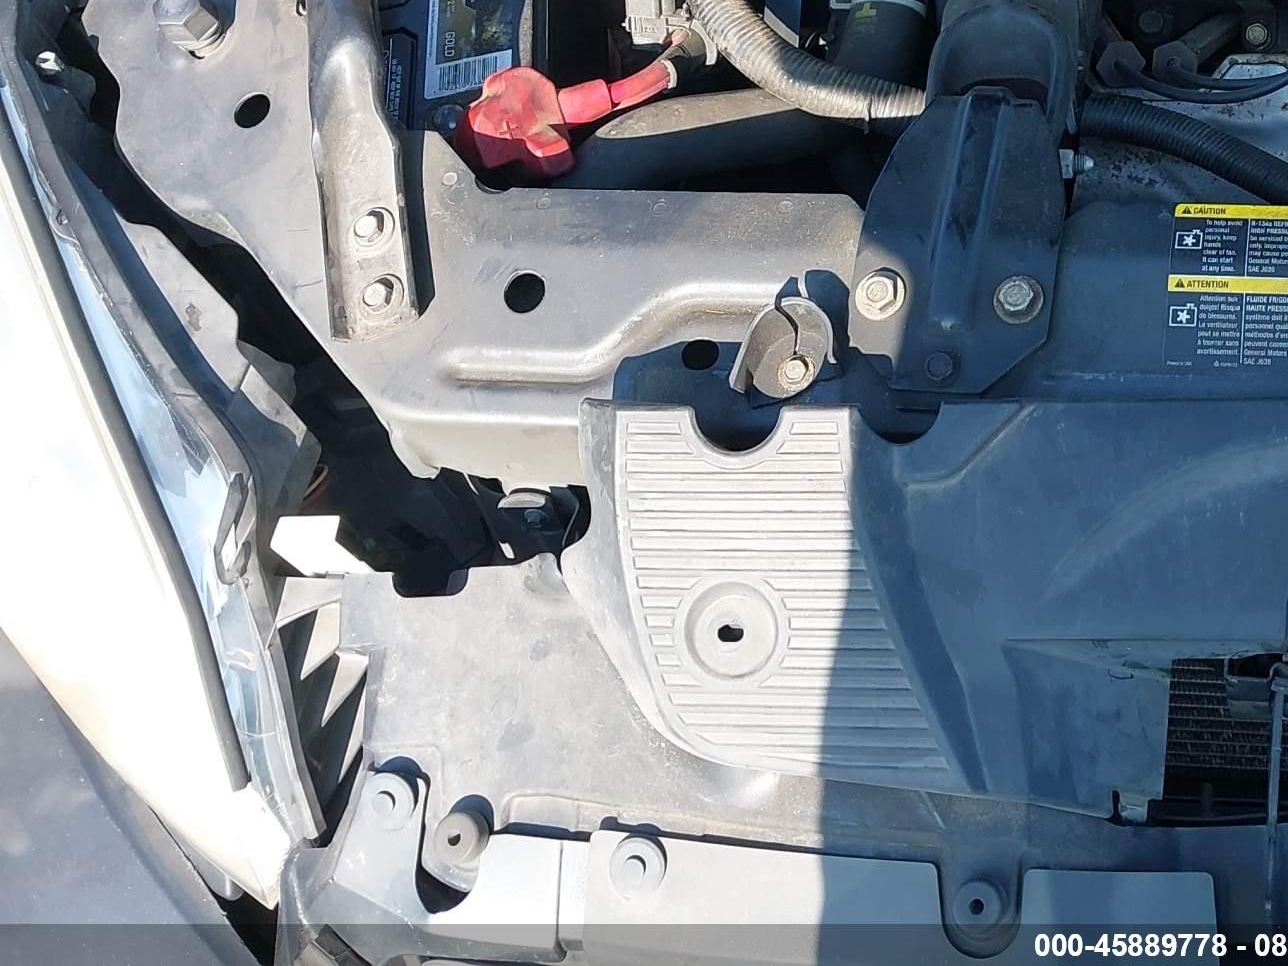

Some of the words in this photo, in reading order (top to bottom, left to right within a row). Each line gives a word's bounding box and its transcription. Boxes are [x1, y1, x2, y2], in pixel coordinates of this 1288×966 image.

[444, 31, 456, 57] GOLD
[1194, 206, 1226, 214] CAUTION
[1187, 280, 1229, 288] ATTENTION
